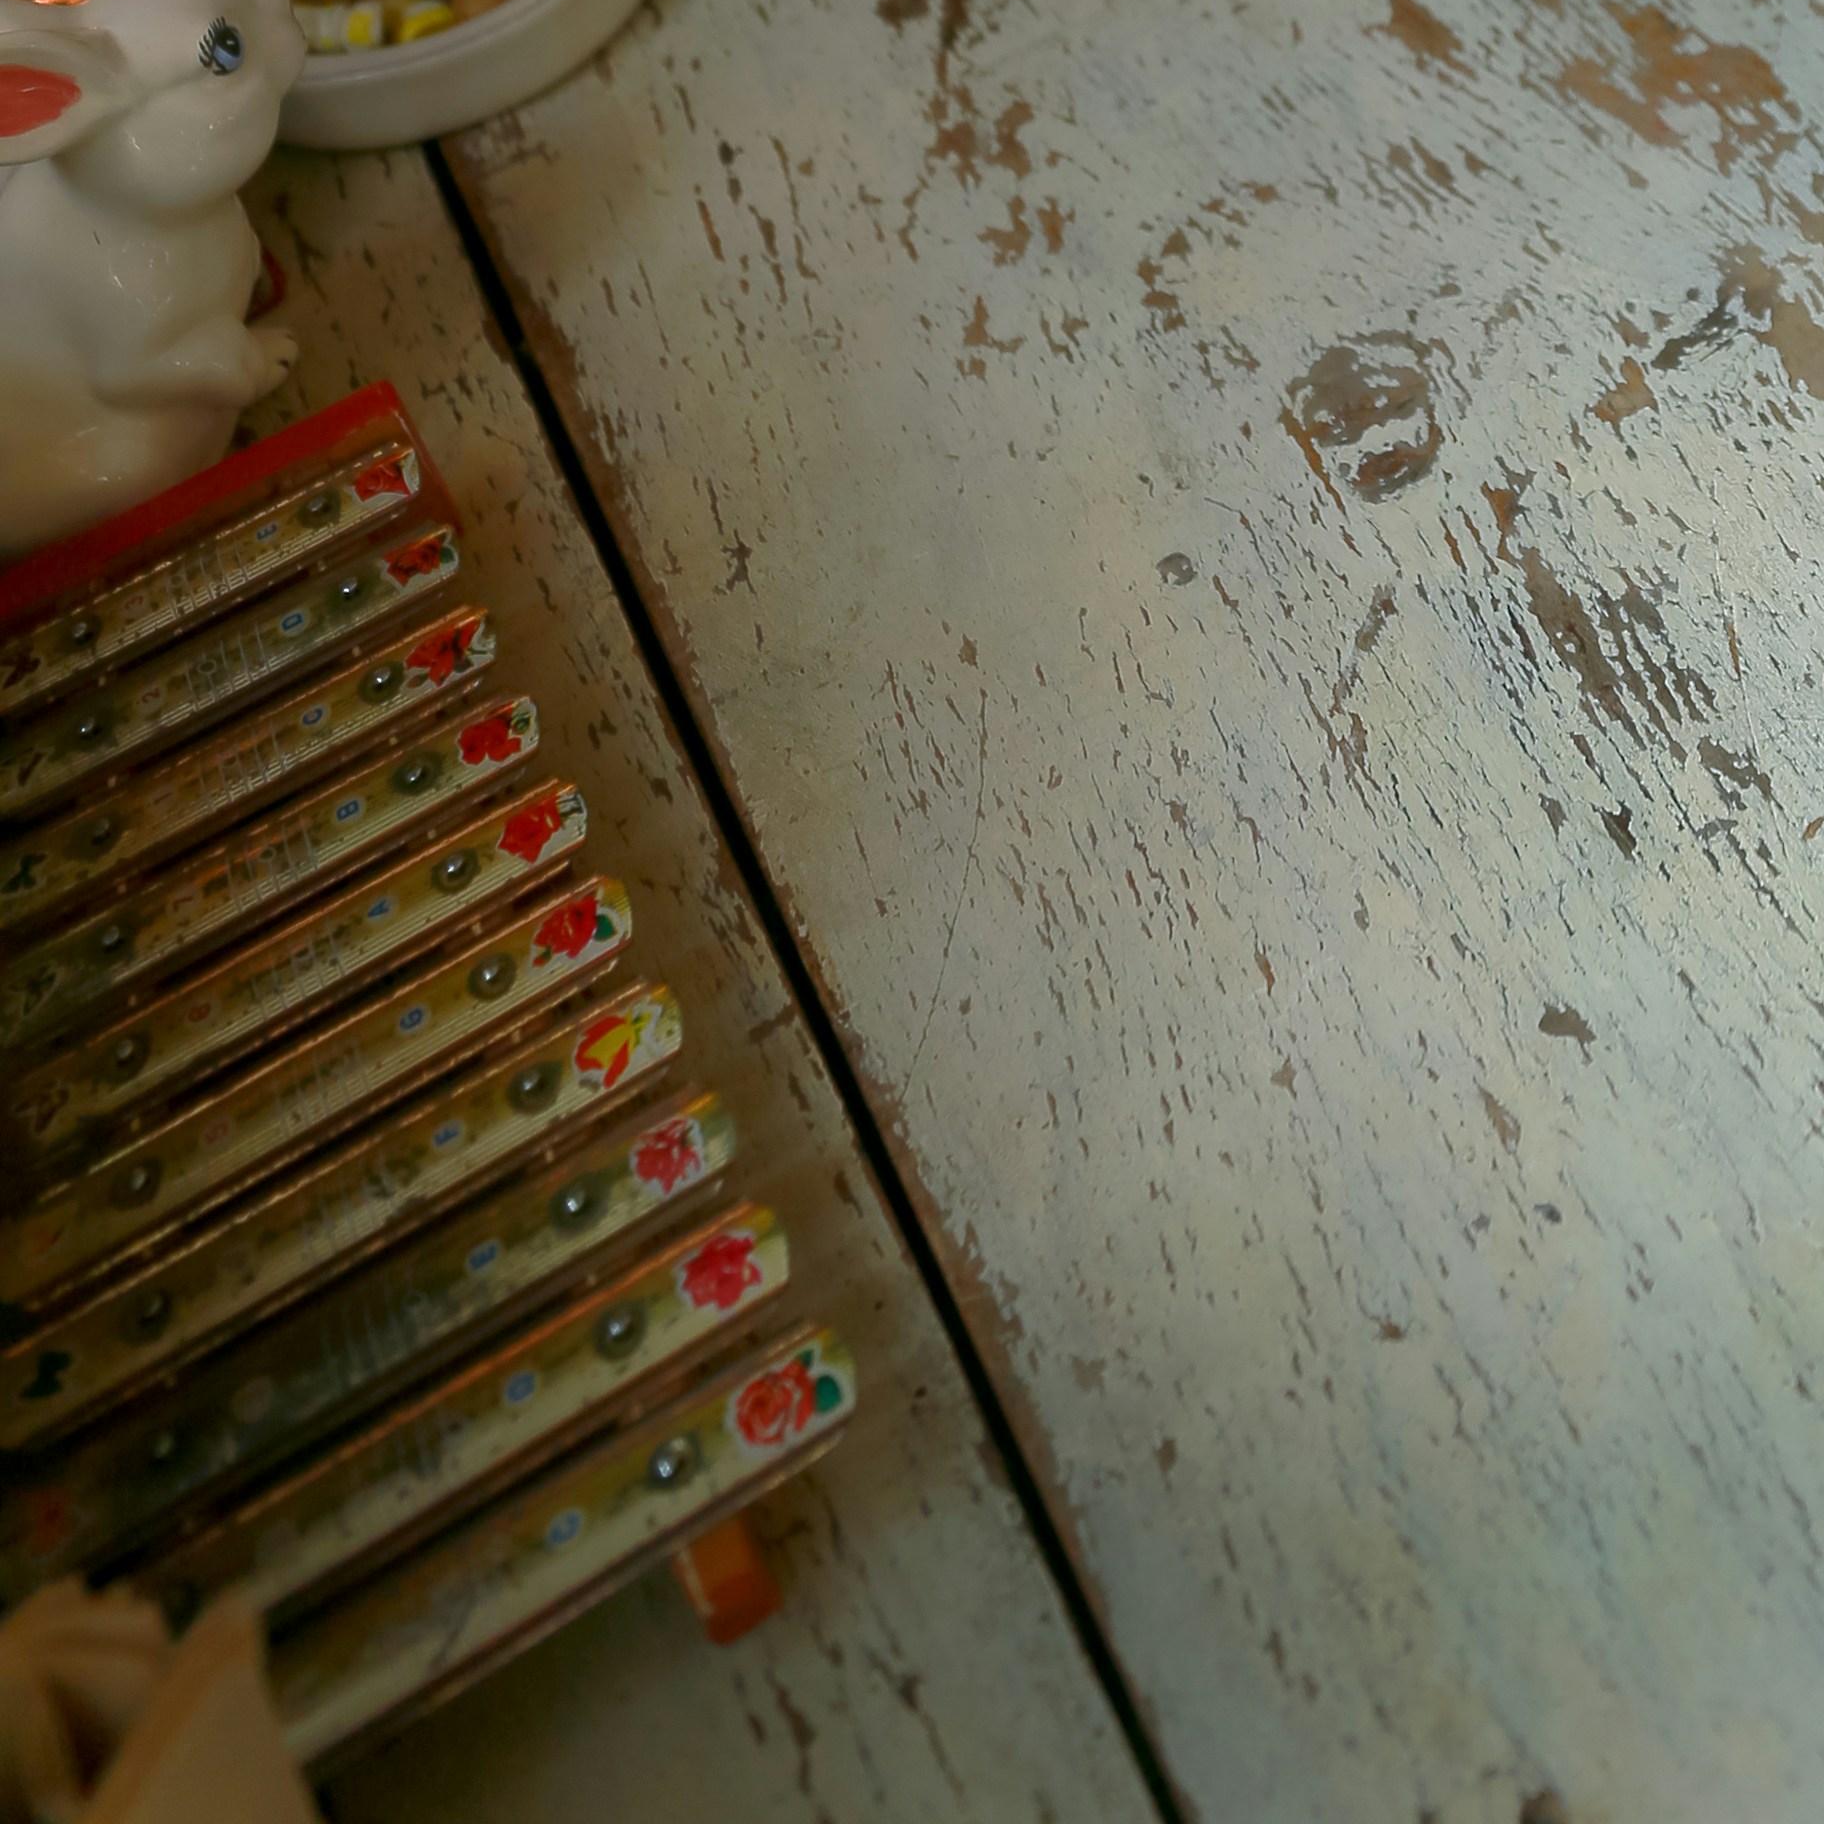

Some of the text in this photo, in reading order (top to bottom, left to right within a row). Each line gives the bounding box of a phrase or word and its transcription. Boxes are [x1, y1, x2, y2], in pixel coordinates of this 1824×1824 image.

[255, 521, 279, 542] E
[280, 611, 304, 633] D
[301, 706, 324, 727] C
[335, 798, 360, 822] B
[366, 898, 391, 921] A
[398, 1007, 426, 1031] G
